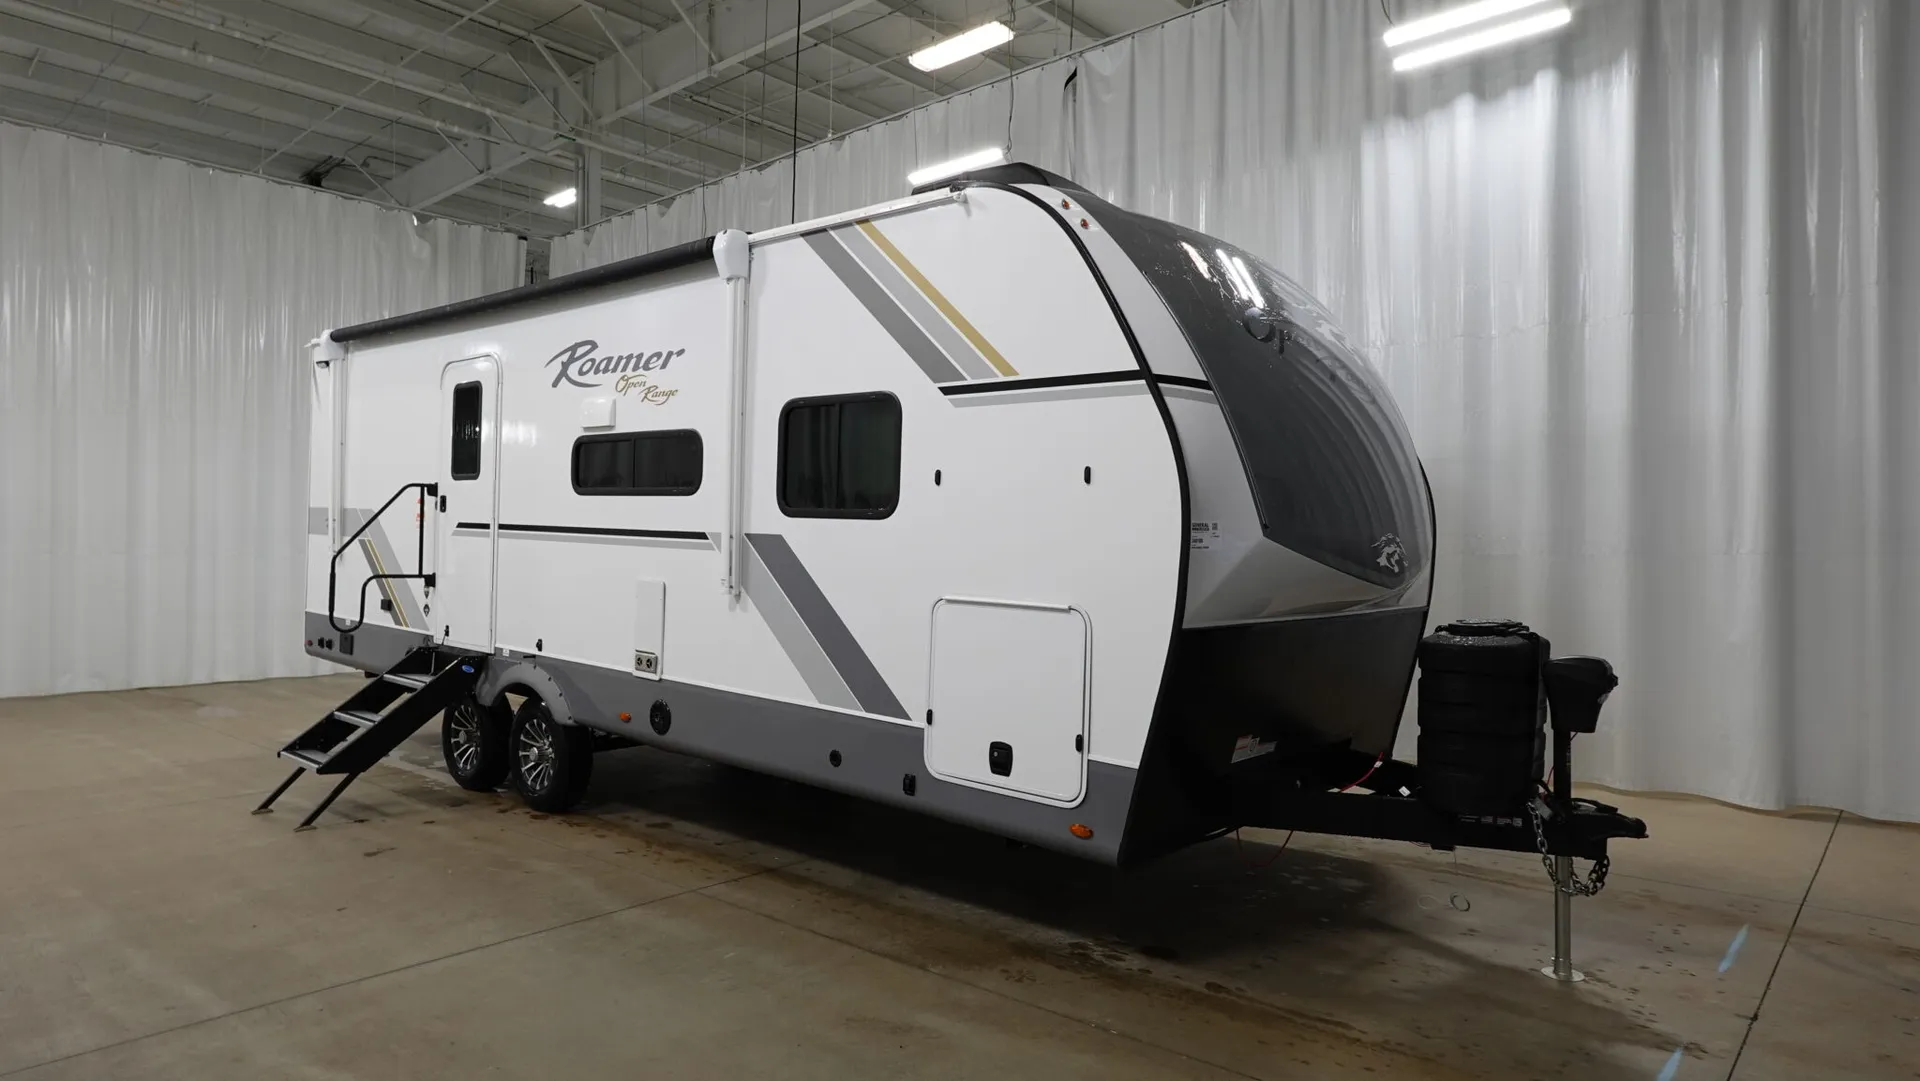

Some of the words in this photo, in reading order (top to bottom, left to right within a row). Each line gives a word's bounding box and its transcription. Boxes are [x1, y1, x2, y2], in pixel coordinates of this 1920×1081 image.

[544, 340, 685, 388] Roamer
[615, 374, 647, 396] Open
[638, 385, 678, 405] Range
